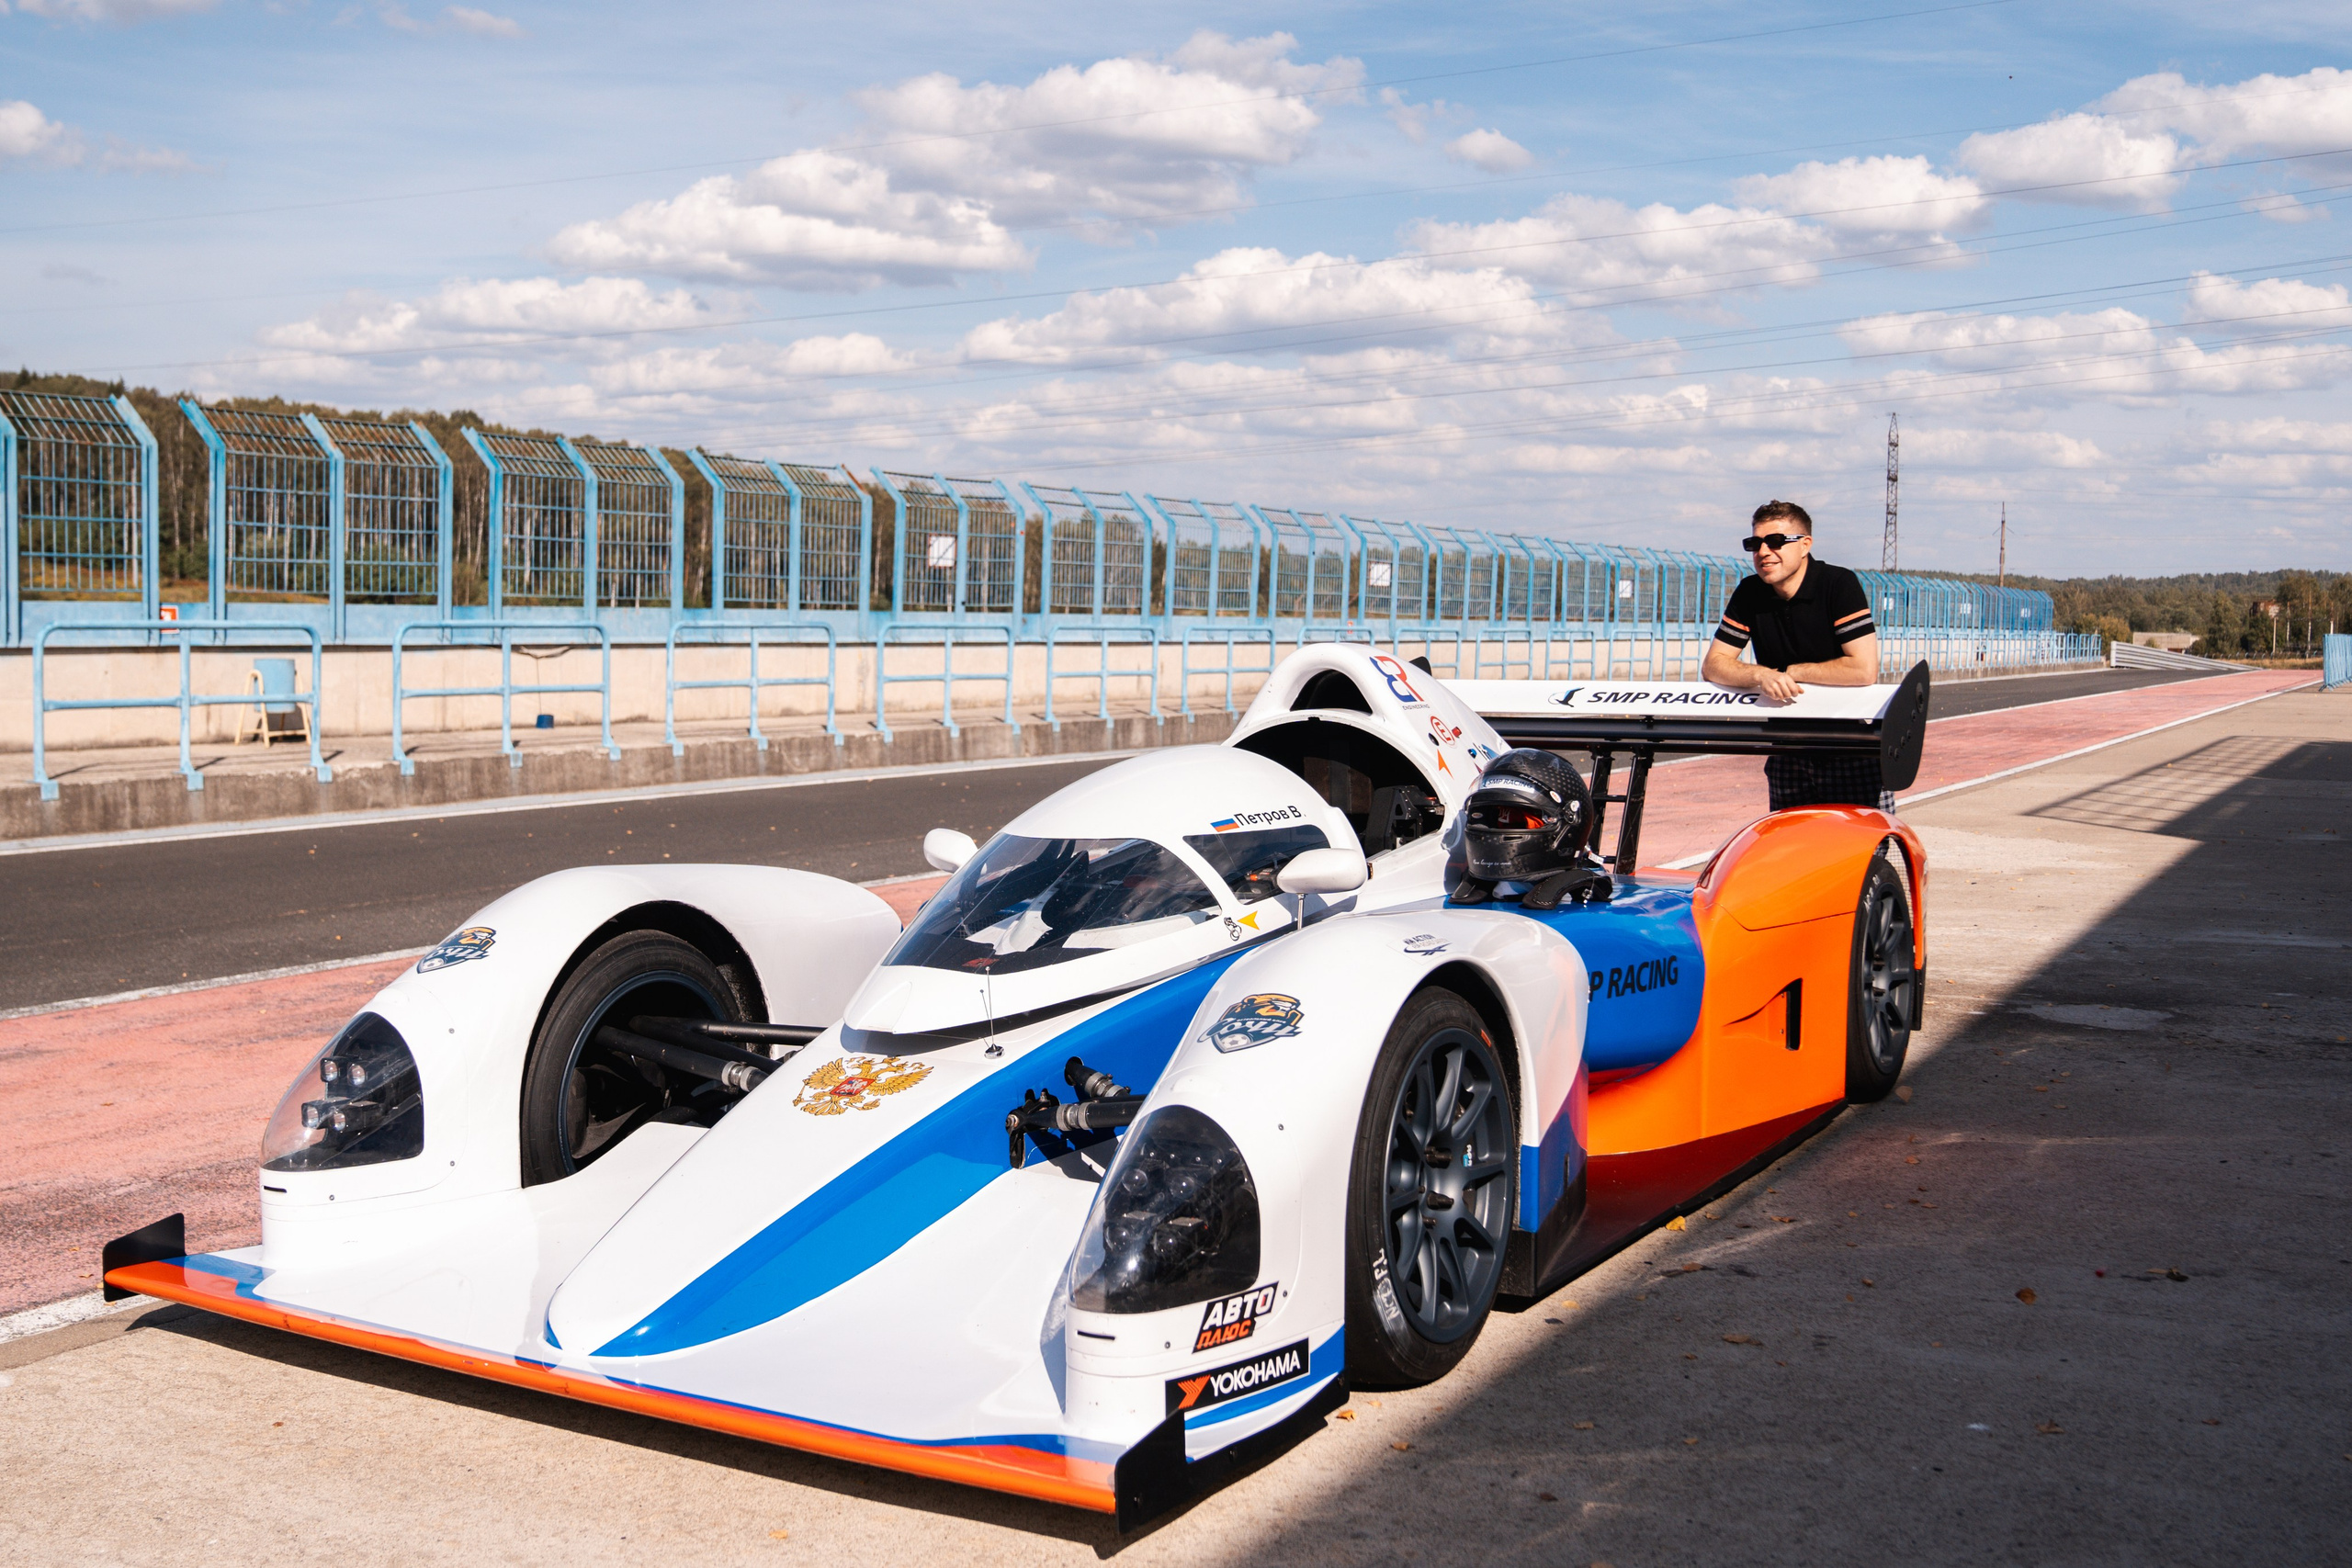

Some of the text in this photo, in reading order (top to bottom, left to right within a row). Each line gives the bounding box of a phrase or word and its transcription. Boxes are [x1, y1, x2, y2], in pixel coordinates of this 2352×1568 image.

[1587, 692, 1760, 705] SMP RACING
[1504, 778, 1533, 789] RACING
[1234, 809, 1290, 826] Петров
[1607, 954, 1679, 999] RACING
[1202, 1286, 1274, 1331] АВТО
[1196, 1319, 1251, 1350] ПЛЮС
[1210, 1349, 1301, 1397] YOKOHAMA
